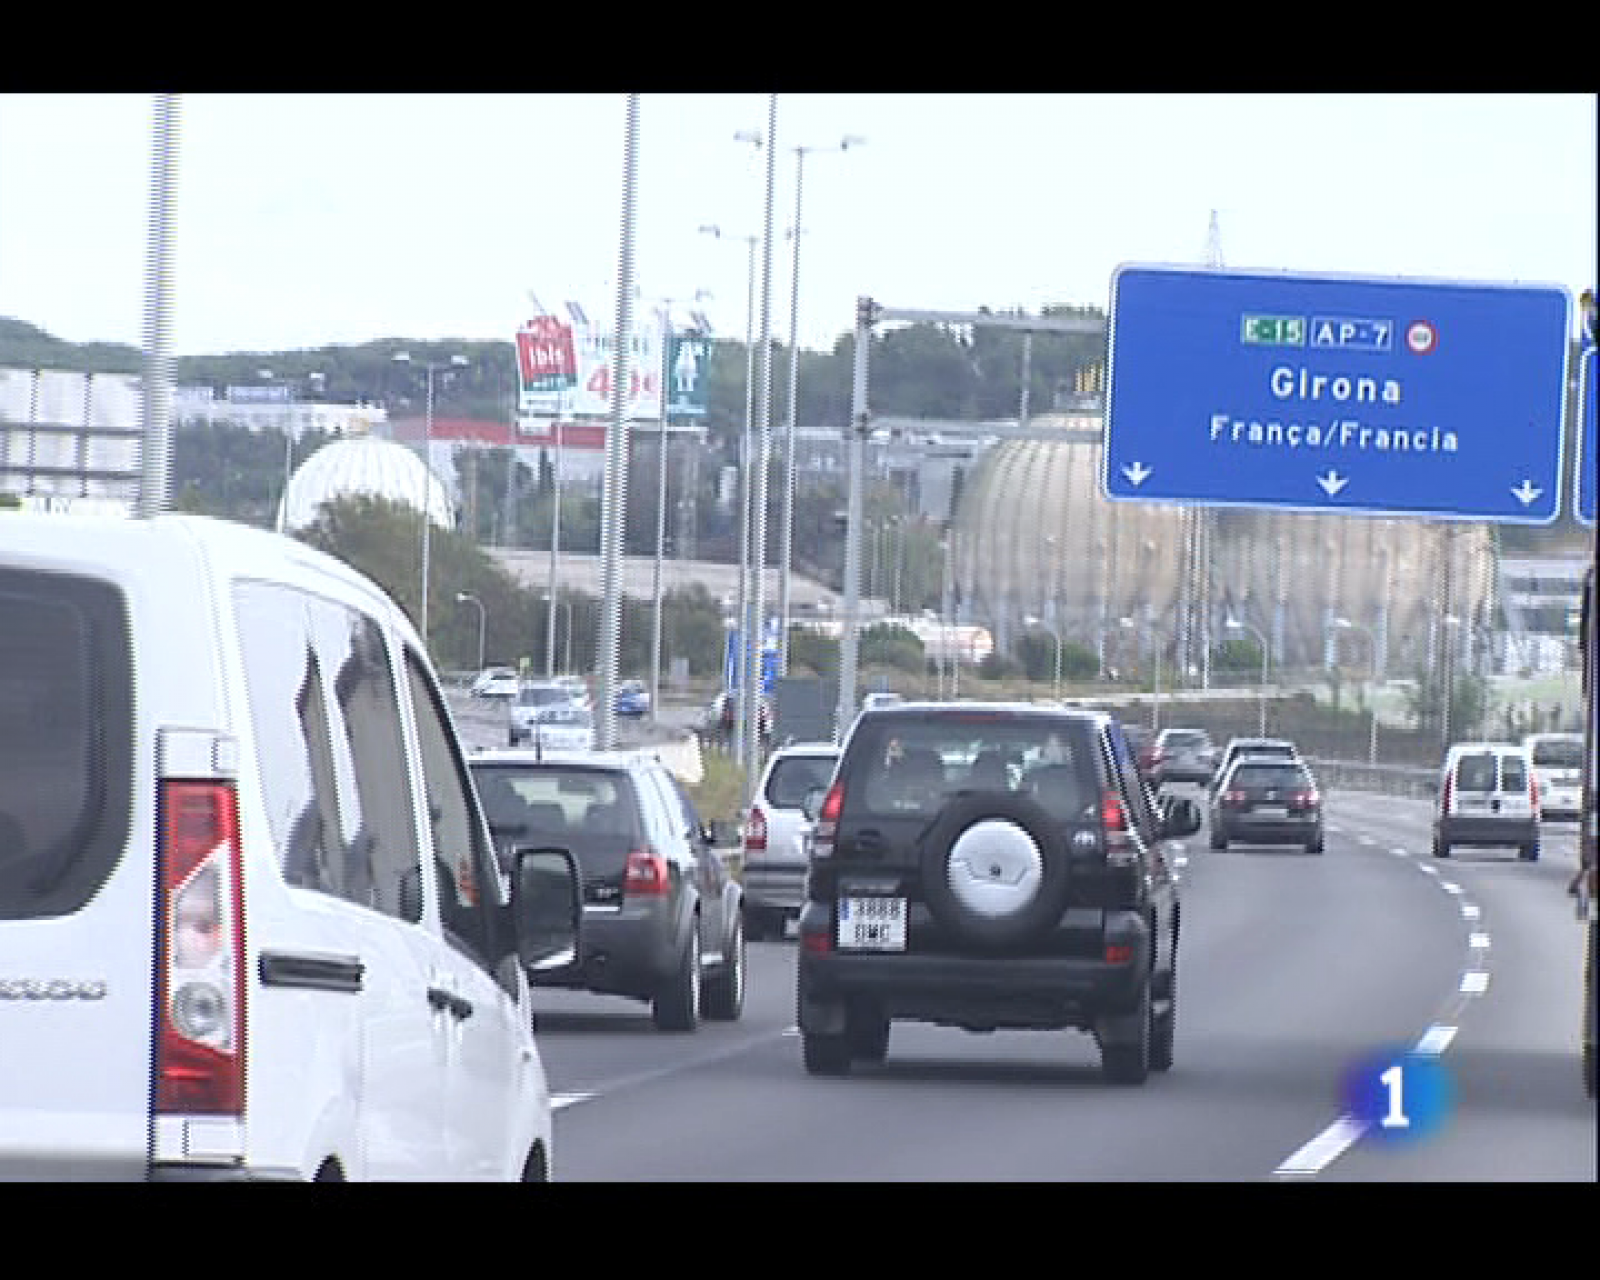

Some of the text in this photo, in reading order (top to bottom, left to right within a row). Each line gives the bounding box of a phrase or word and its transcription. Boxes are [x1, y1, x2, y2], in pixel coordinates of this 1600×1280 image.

[1244, 318, 1302, 343] E-15
[1316, 320, 1389, 347] AP-7
[1270, 366, 1401, 404] Girona
[1209, 414, 1459, 452] França/Francia
